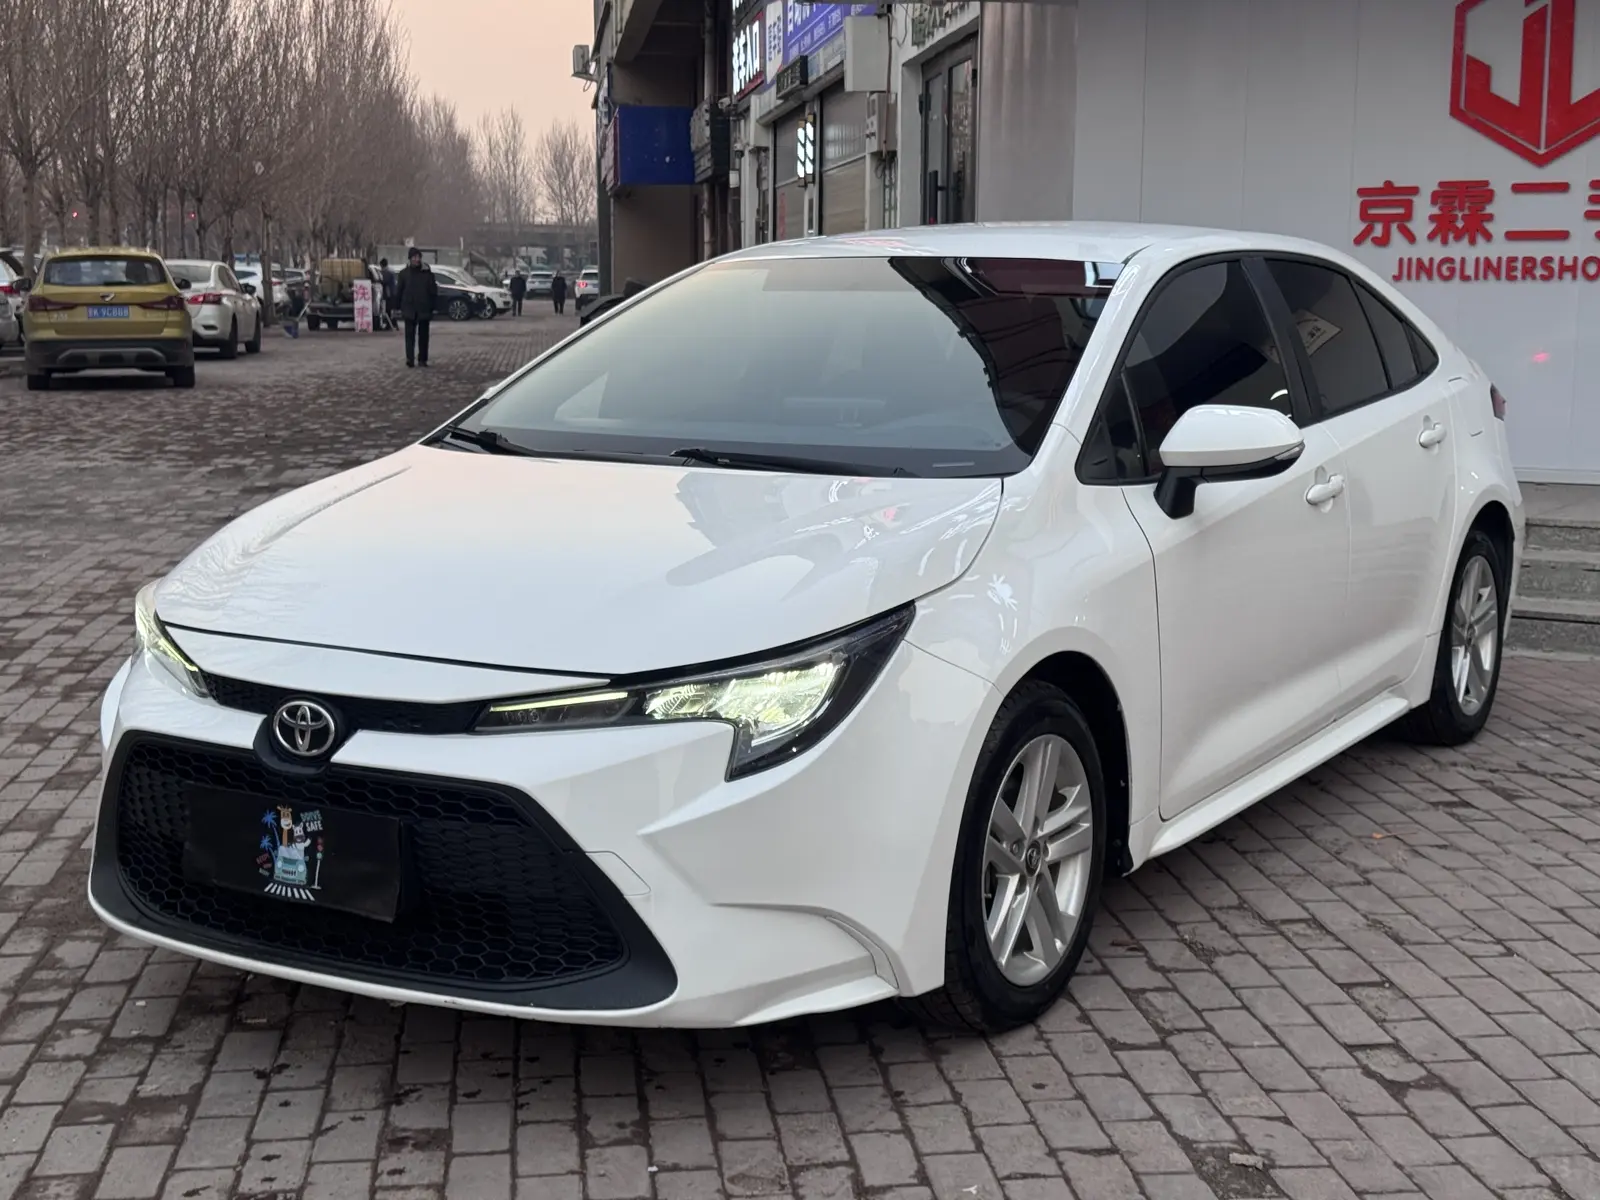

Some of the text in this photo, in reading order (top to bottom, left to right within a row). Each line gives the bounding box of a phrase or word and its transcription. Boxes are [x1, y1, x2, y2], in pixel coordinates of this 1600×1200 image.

[1353, 180, 1600, 247] 京霖二
[1392, 256, 1600, 282] JINGLINERSHO
[306, 820, 324, 832] SAFE
